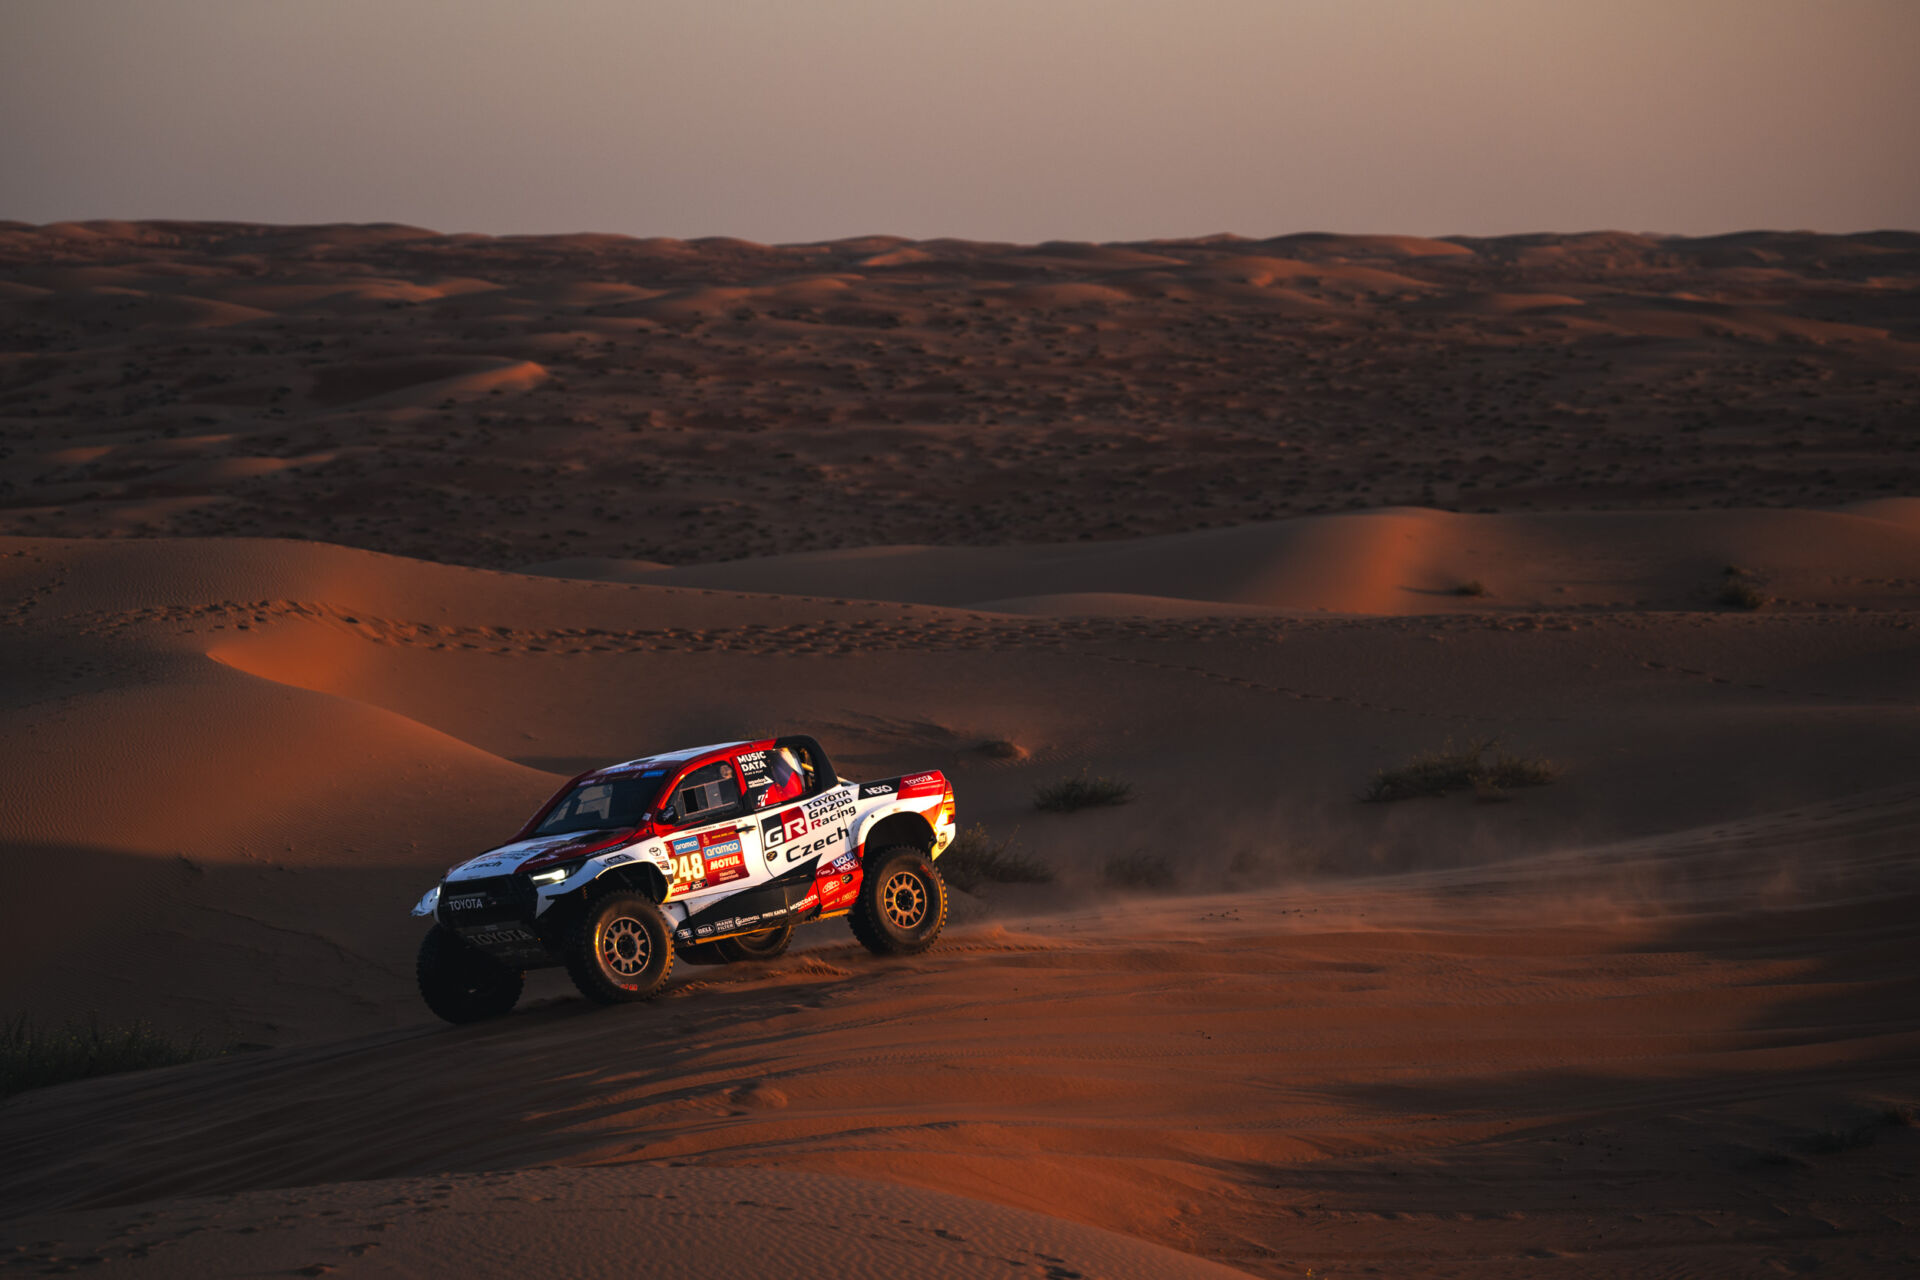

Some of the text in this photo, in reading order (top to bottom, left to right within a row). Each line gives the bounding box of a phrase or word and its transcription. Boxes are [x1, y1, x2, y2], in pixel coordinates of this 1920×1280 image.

[736, 751, 767, 764] MUSIC
[740, 760, 767, 772] DATA
[904, 775, 934, 785] TOYOTA
[802, 789, 851, 810] TOYOTA
[808, 797, 853, 820] GAZOO
[810, 806, 857, 830] Racing
[764, 817, 807, 848] GR
[675, 840, 698, 850] aramco
[706, 842, 739, 857] aramco
[786, 827, 849, 862] Czech
[670, 852, 705, 884] 248
[710, 856, 740, 870] MOTUL
[837, 859, 859, 873] MOLY
[448, 898, 483, 911] TOYOTA
[697, 926, 712, 935] BELL
[717, 923, 734, 931] FILTER
[467, 929, 533, 945] TOYOTA
